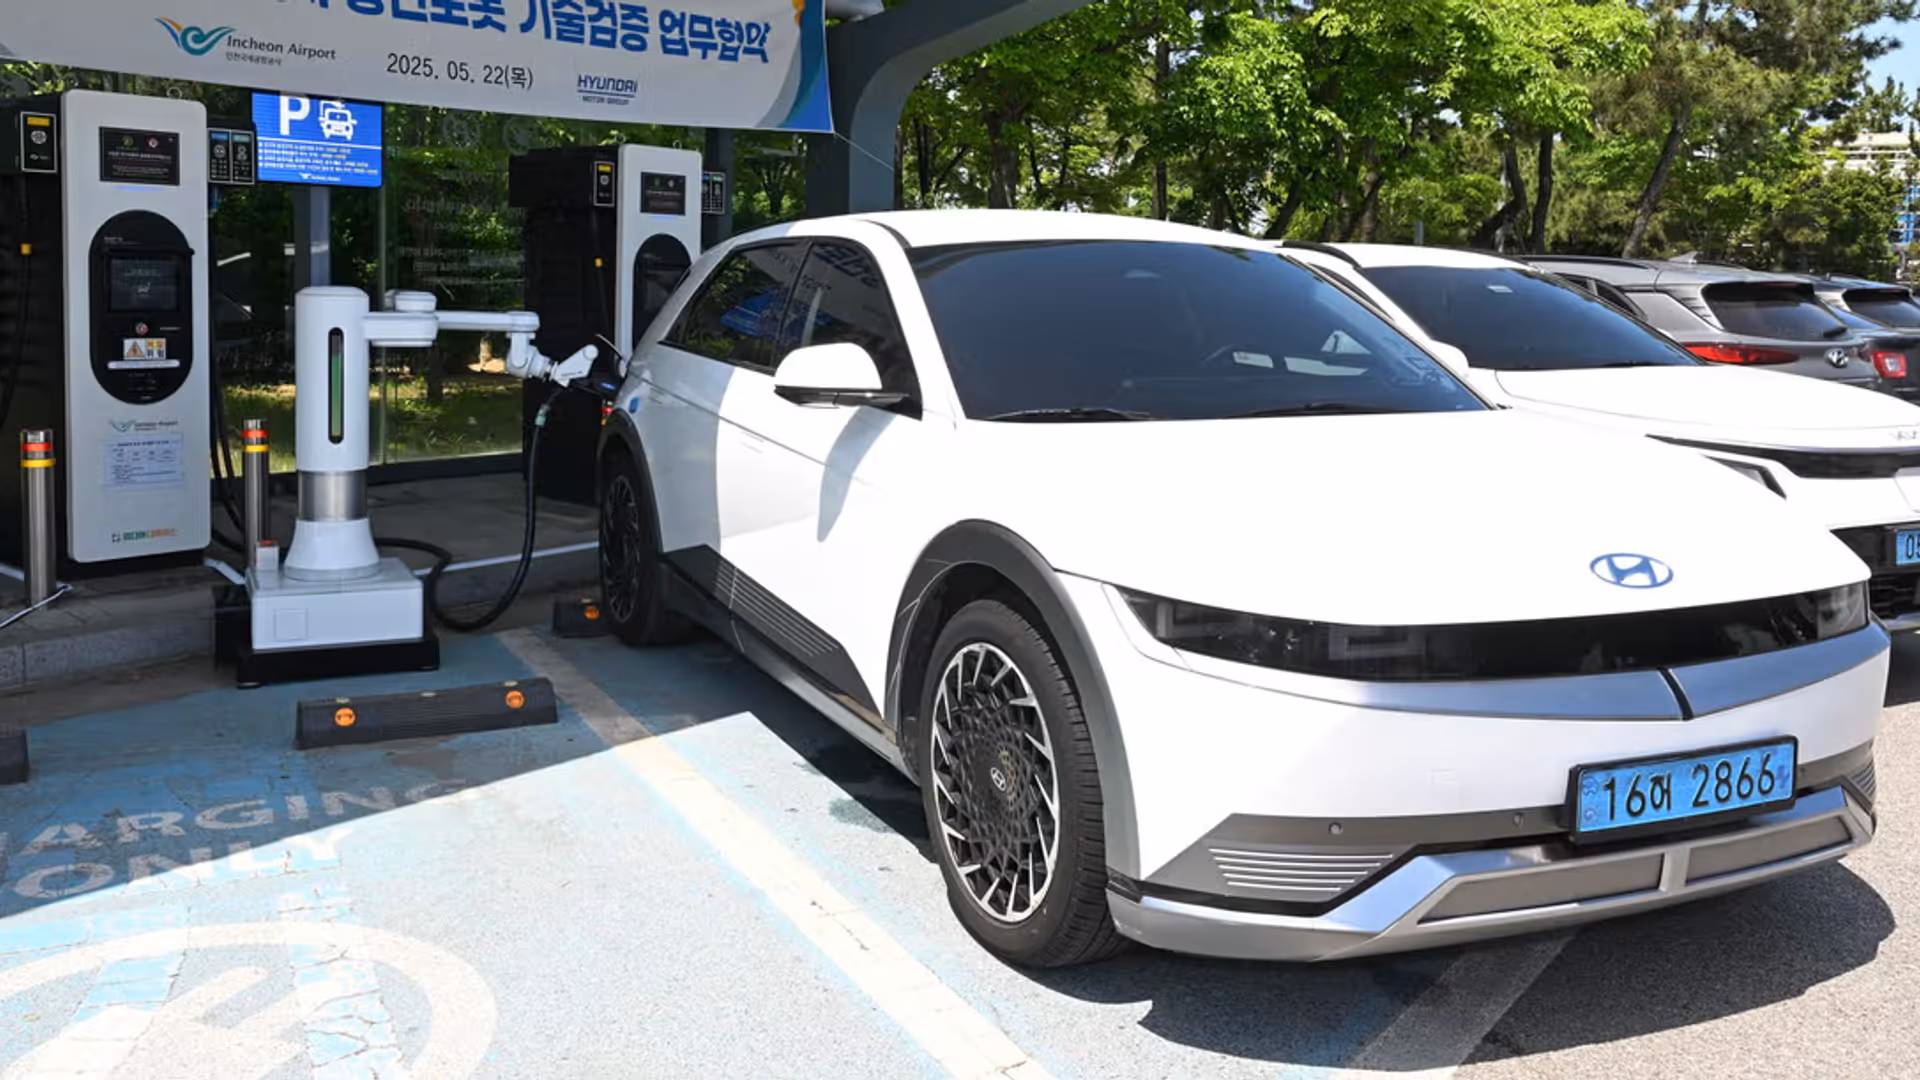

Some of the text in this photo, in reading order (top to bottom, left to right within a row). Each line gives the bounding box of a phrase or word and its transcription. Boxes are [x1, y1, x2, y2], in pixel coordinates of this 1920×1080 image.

[226, 34, 337, 60] Incheon Airport
[519, 0, 650, 52] 기술검증
[658, 8, 772, 64] 업무협약
[386, 52, 534, 91] 2025. 05. 22(목)
[577, 74, 639, 94] HYUNDAI
[280, 96, 310, 135] P
[1692, 752, 1776, 808] 2866
[13, 829, 354, 898] ONLY
